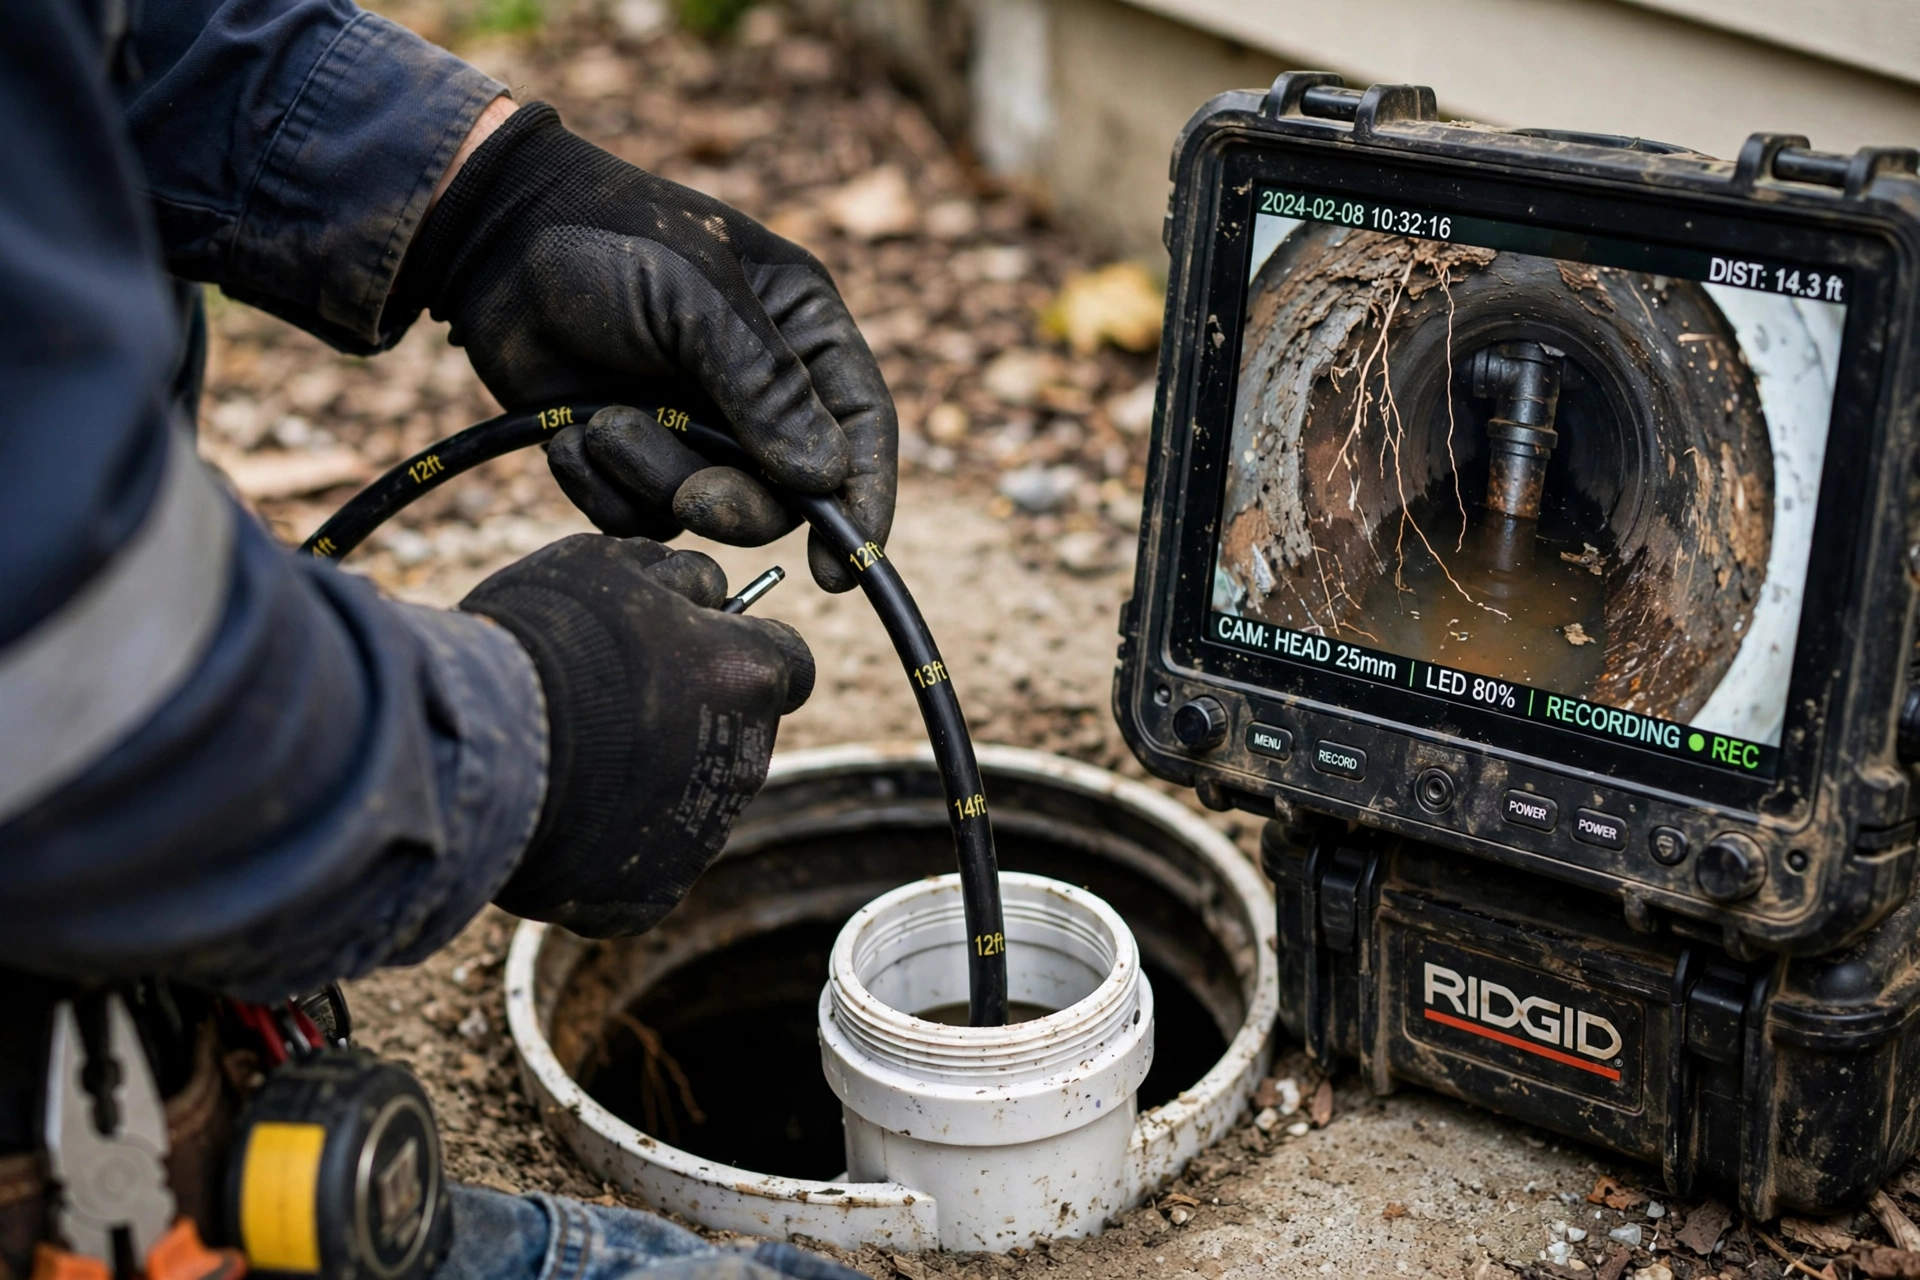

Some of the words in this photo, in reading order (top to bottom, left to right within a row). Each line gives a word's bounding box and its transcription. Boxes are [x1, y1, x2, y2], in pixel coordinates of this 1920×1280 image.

[1261, 191, 1364, 225] 2024-02-08
[1372, 207, 1451, 239] 10:32:16
[1709, 257, 1767, 289] DIST:
[1775, 268, 1821, 297] 14.3
[1826, 275, 1843, 302] ft
[537, 406, 573, 430] 13ft
[656, 407, 690, 432] 13ft
[408, 454, 445, 484] 12ft
[850, 541, 884, 571] 12ft
[914, 660, 948, 688] 13ft
[1218, 616, 1269, 648] CAM:
[1275, 628, 1330, 662] HEAD
[1336, 645, 1397, 680] 25mm
[1426, 666, 1467, 696] LED
[1472, 678, 1516, 709] 80%
[1546, 695, 1681, 749] RECORDING
[1711, 736, 1760, 769] REC
[1254, 732, 1281, 750] MENU
[1319, 750, 1357, 770] RECORD
[955, 794, 987, 821] 14ft
[1509, 801, 1547, 821] POWER
[1578, 819, 1617, 841] POWER
[975, 932, 1005, 956] 12ft
[1424, 961, 1623, 1061] RIDGID
